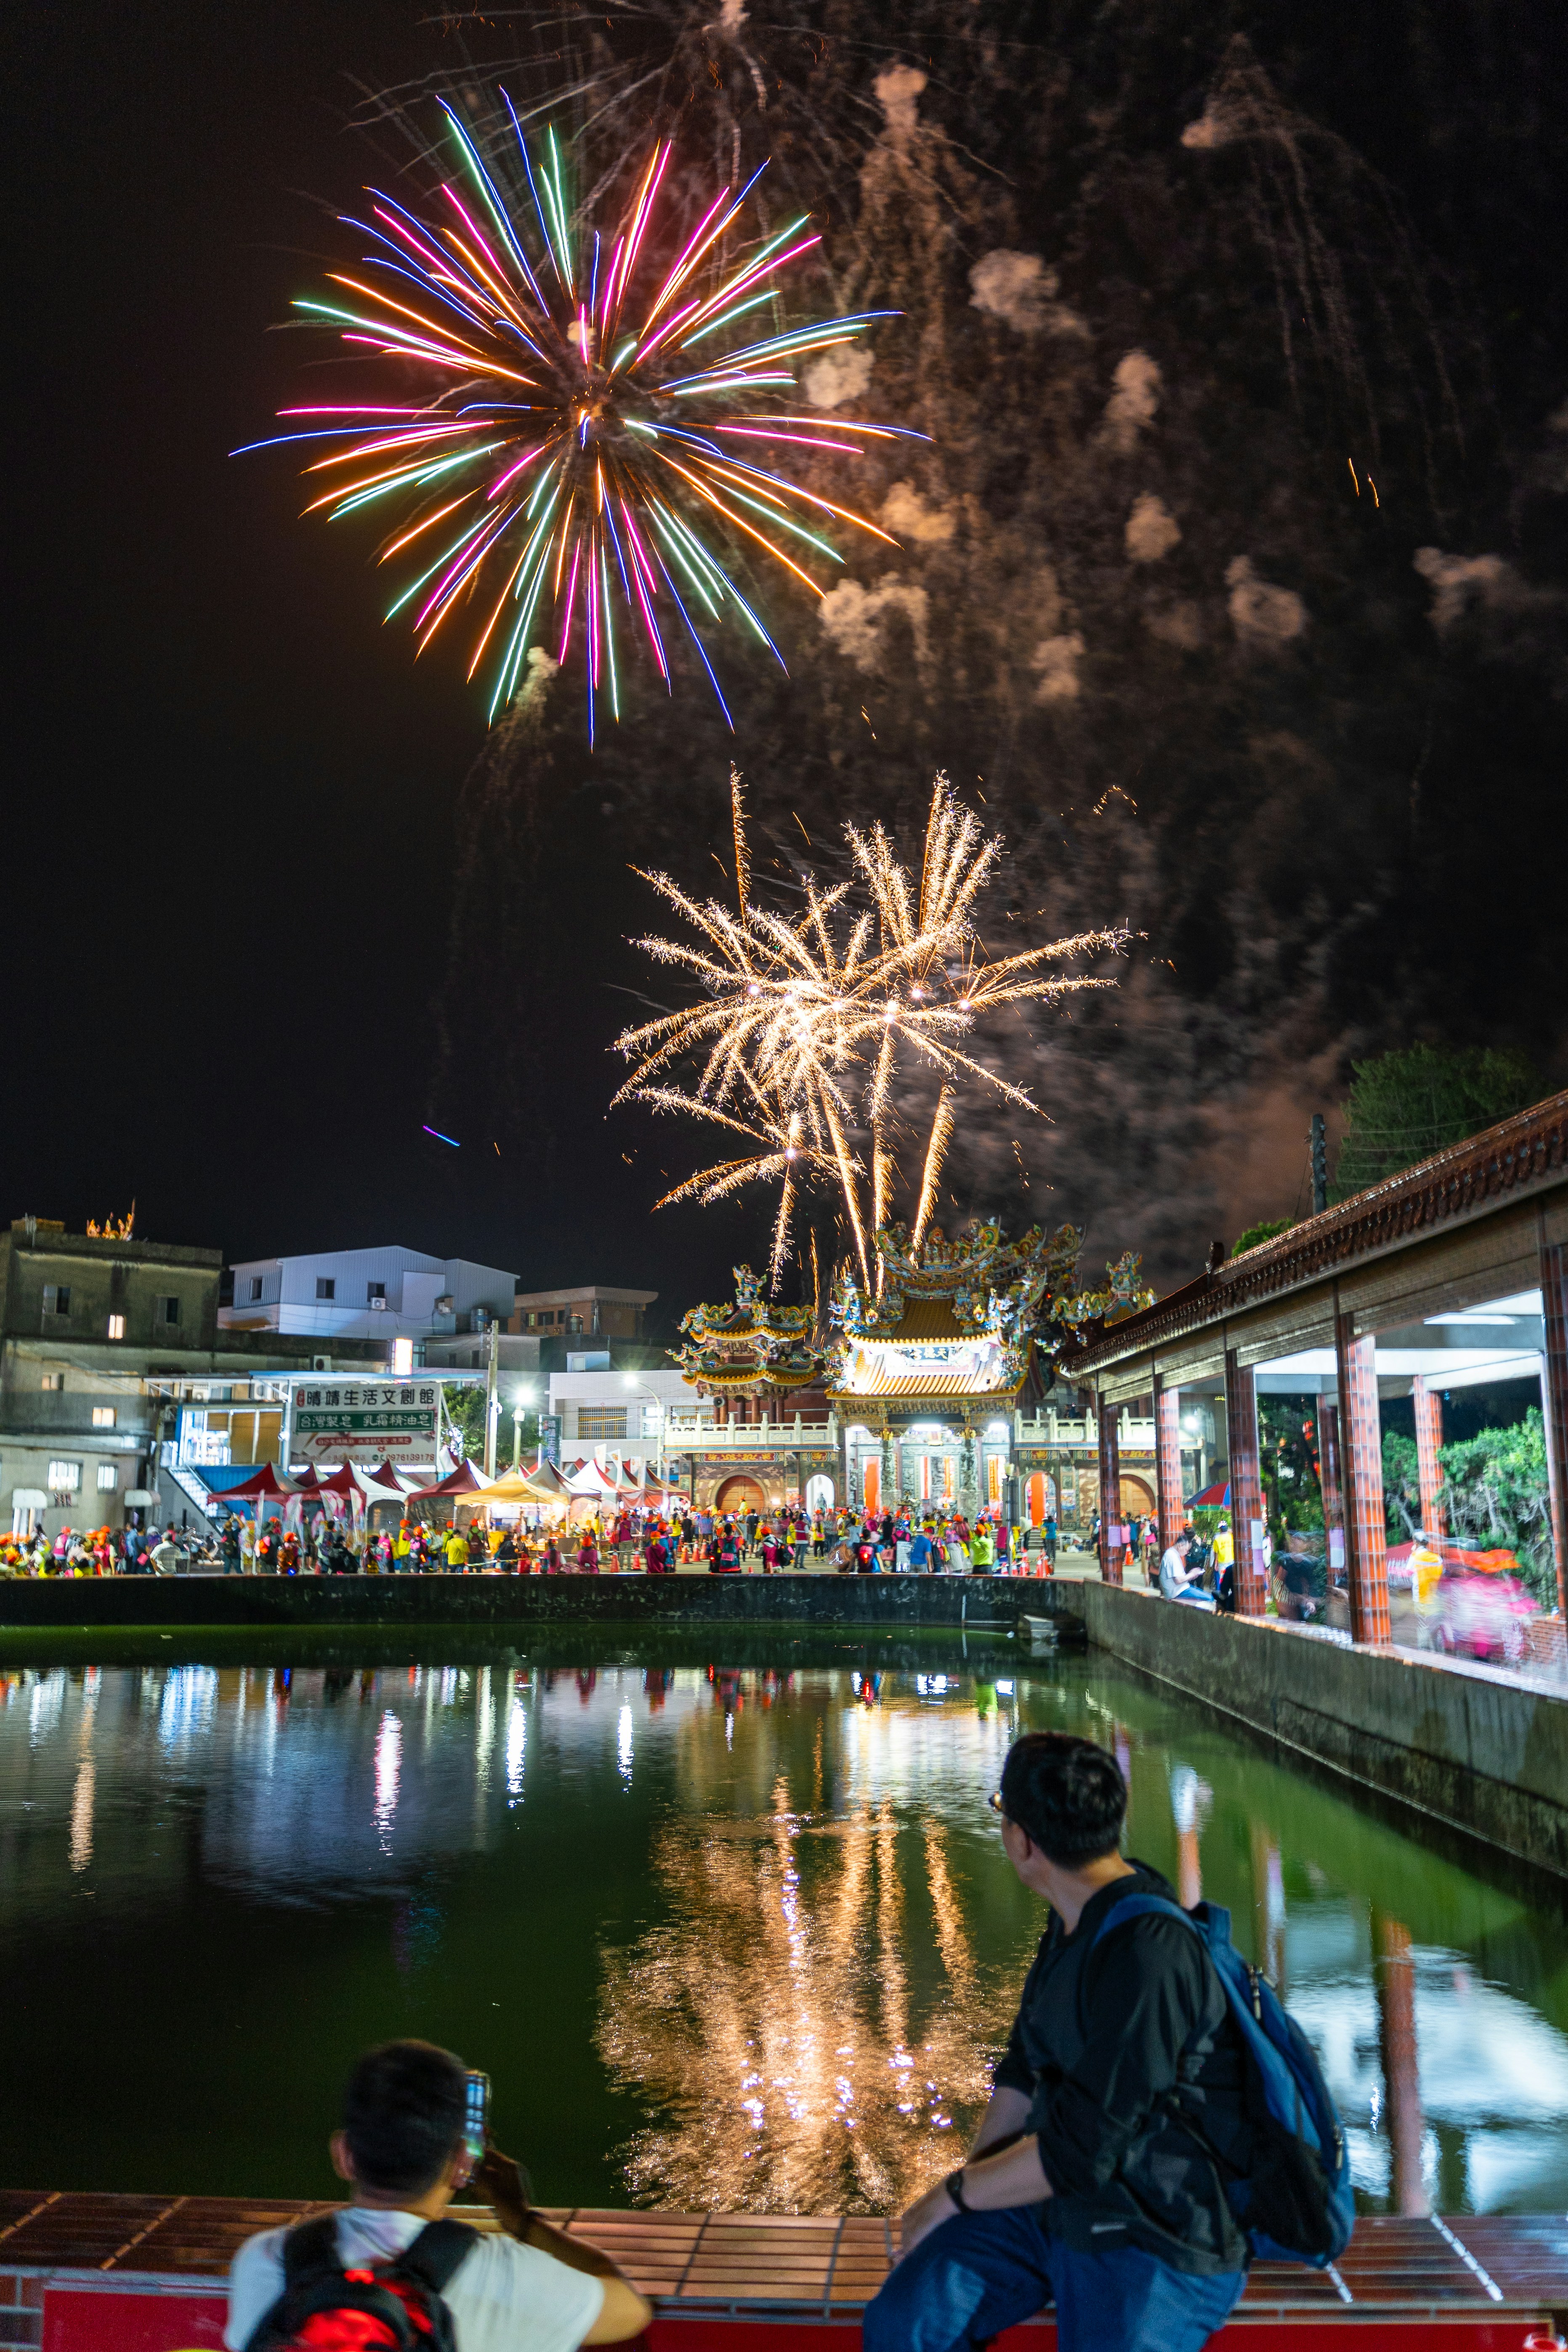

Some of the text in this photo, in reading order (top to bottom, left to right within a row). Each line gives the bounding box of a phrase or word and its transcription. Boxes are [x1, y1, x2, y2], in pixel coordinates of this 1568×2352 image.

[306, 1388, 434, 1406] 晴靖生活文創館
[300, 1414, 431, 1428] 台灣製皂 乳霜精油皂
